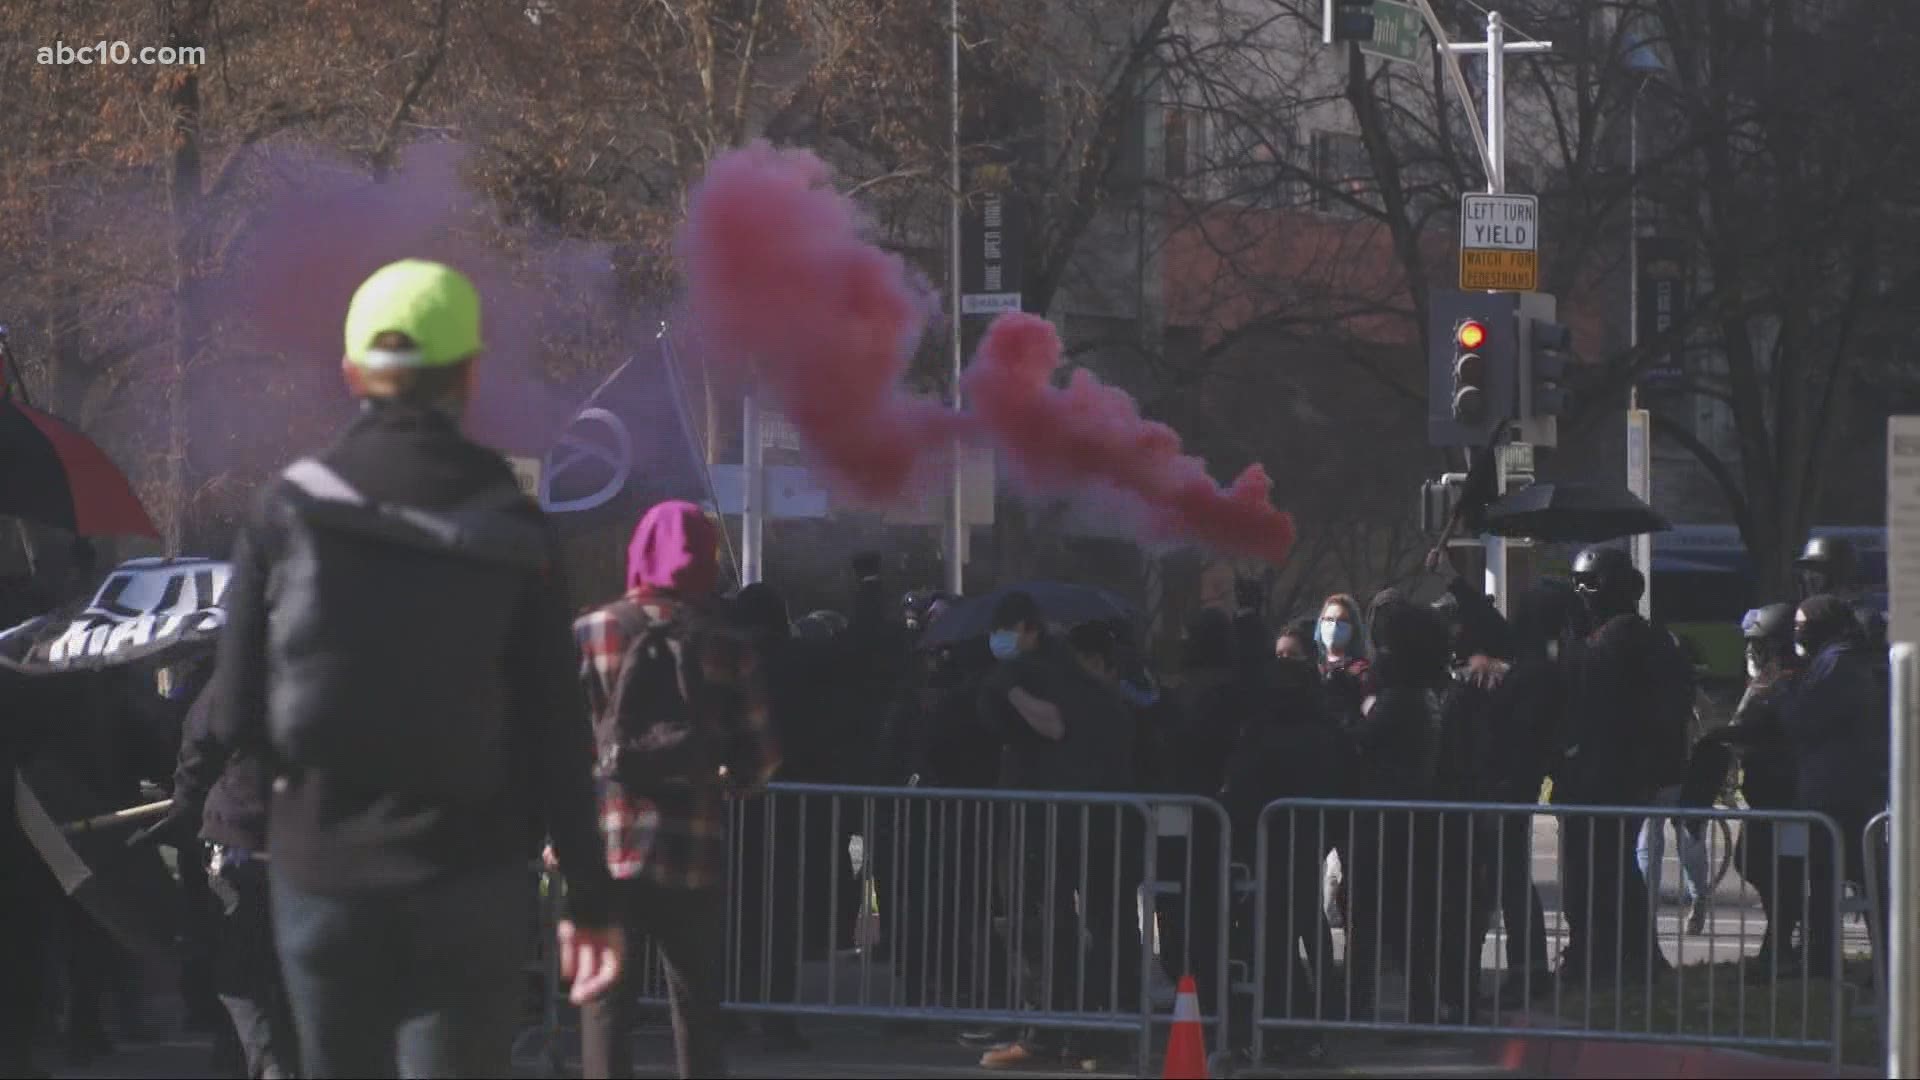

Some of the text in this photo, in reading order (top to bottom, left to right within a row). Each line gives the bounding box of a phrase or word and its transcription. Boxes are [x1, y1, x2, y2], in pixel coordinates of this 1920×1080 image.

[1467, 201, 1533, 222] LEFT TURN
[1475, 224, 1526, 244] YIELD
[1466, 252, 1534, 268] WATCH FOR
